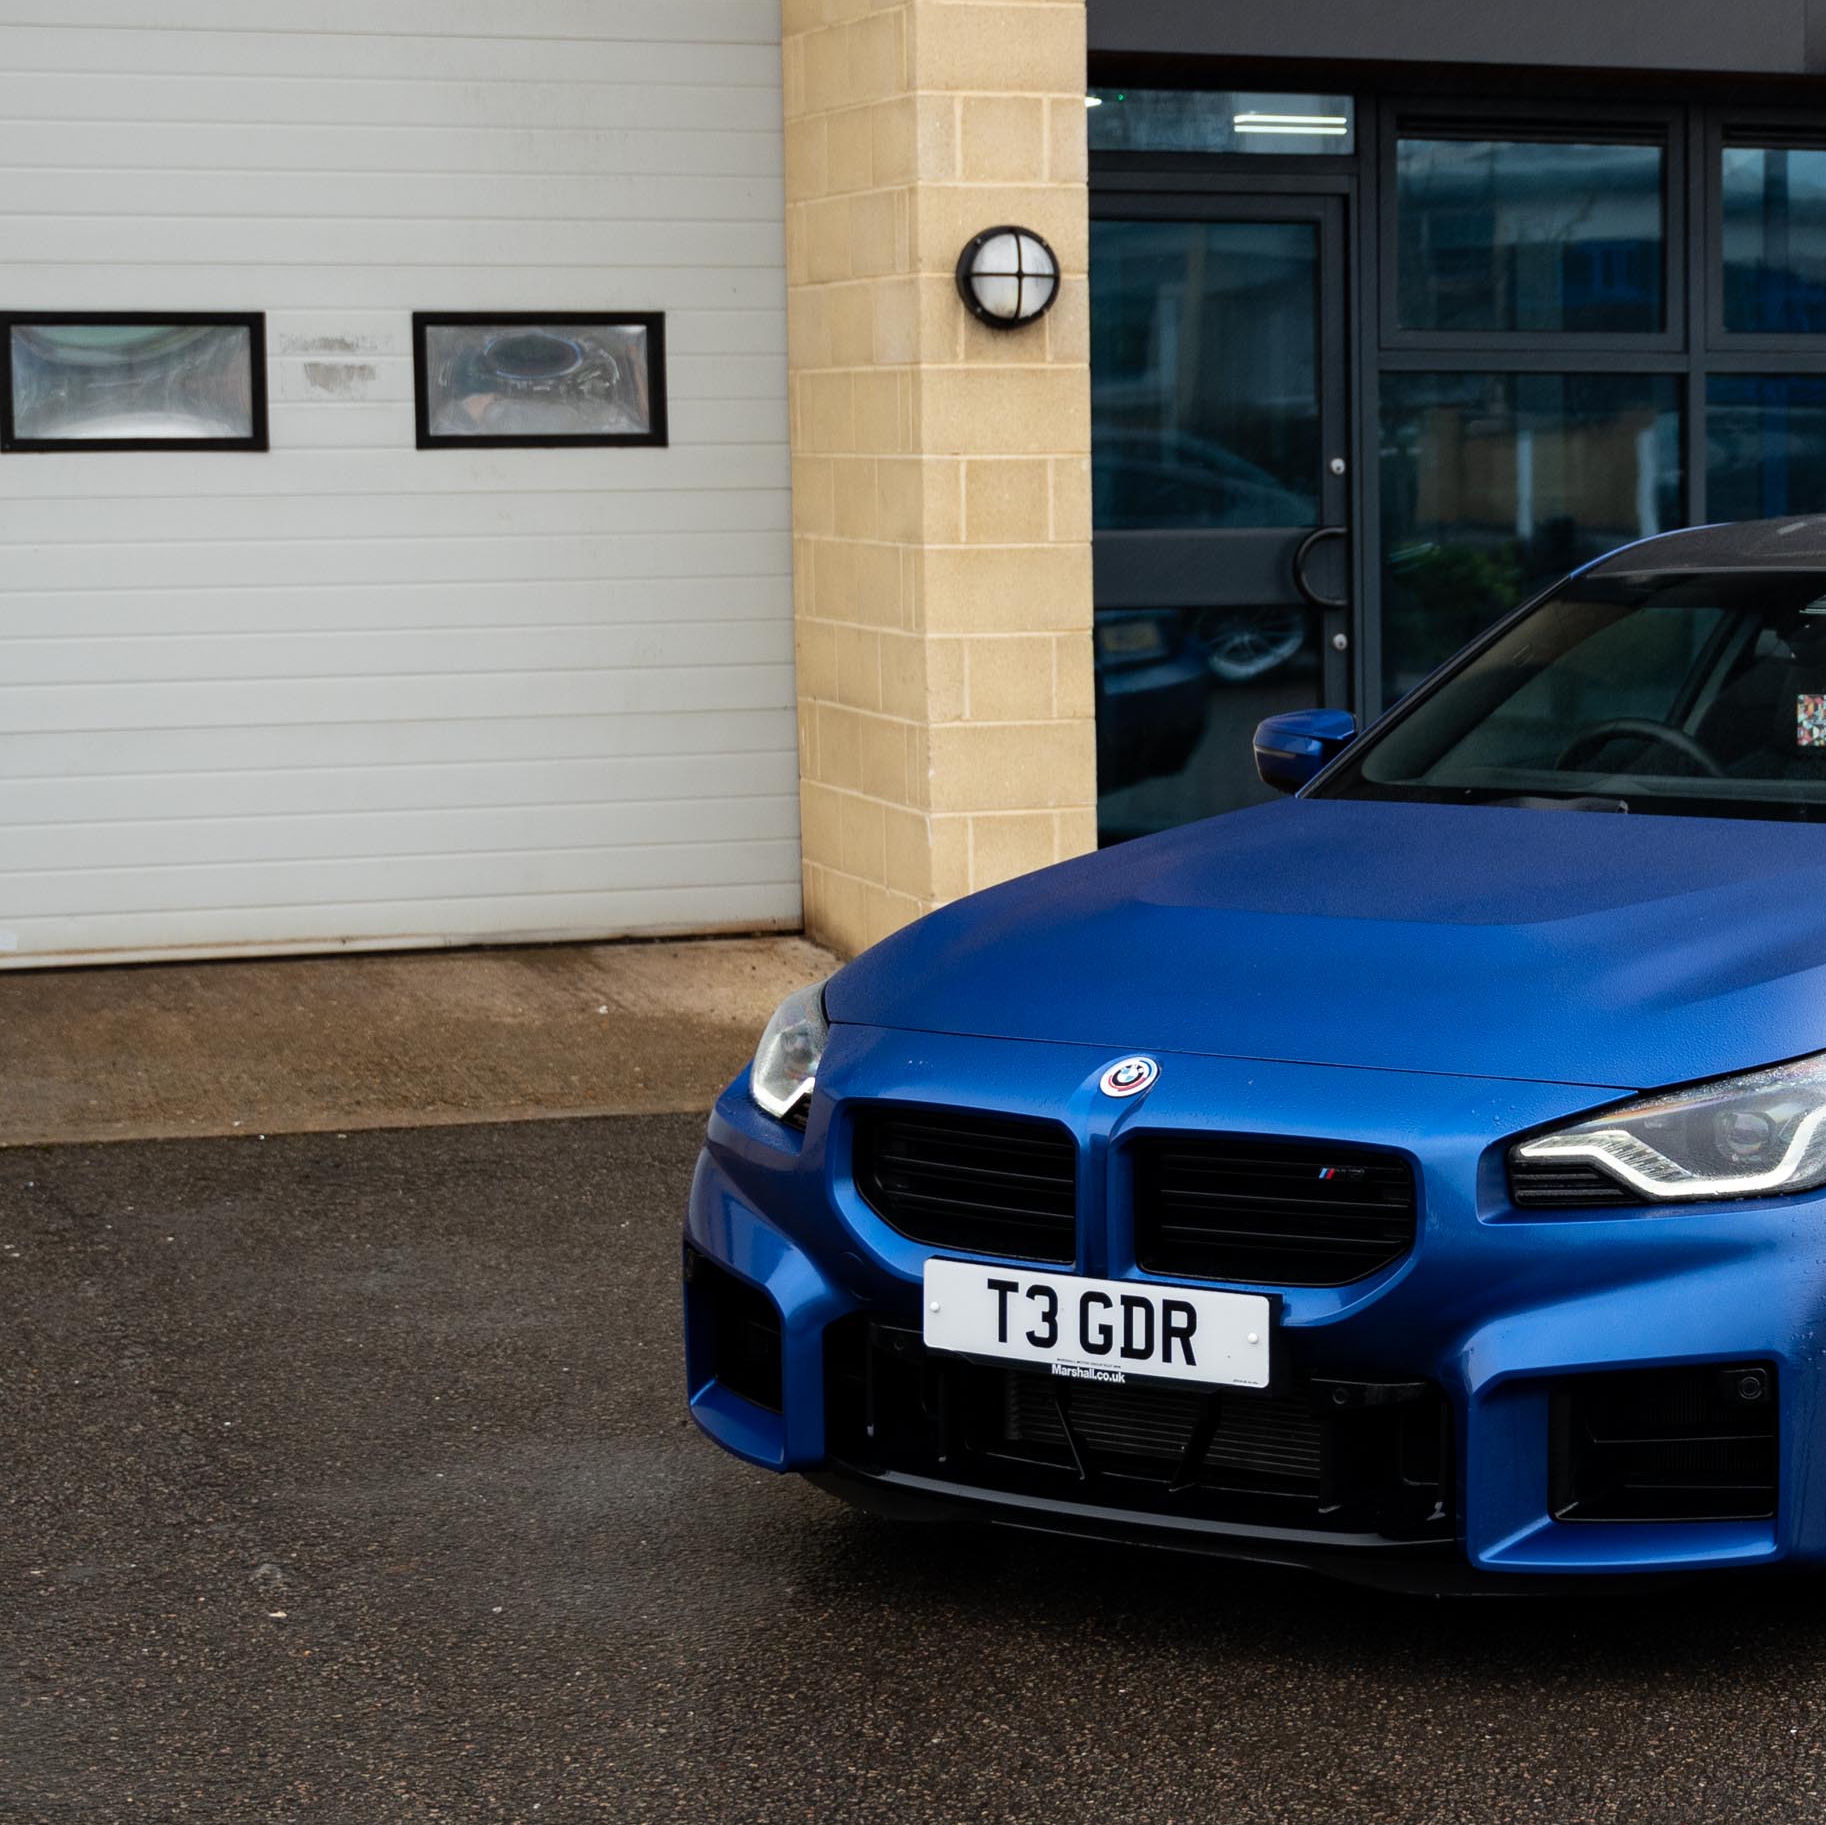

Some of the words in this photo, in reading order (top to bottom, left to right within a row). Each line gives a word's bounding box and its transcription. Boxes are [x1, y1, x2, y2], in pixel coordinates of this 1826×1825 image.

[987, 1278, 1058, 1349] T3
[1079, 1291, 1197, 1366] GDR
[1051, 1363, 1126, 1383] Marshall.co.uk
